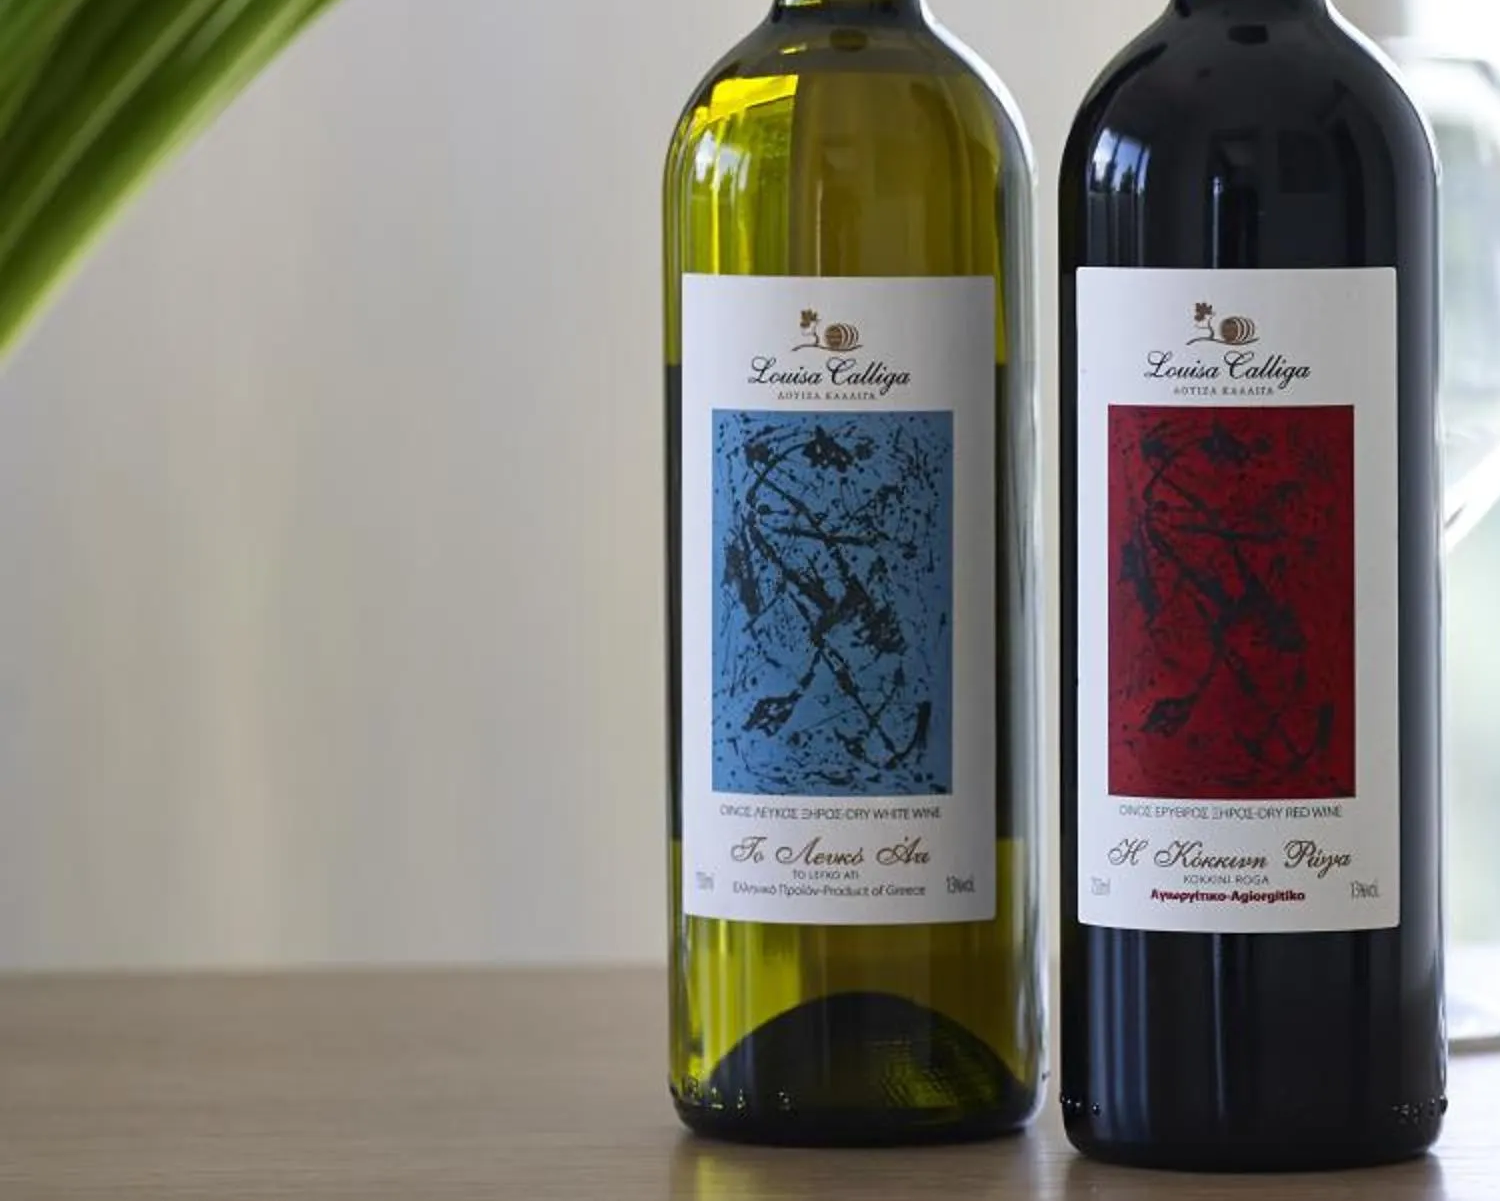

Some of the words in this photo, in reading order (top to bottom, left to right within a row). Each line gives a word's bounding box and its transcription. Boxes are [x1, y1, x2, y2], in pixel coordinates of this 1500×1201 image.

[748, 356, 822, 384] Louisa
[826, 356, 912, 396] Calliga
[1144, 350, 1220, 379] Louisa
[1223, 350, 1311, 390] Calliga
[872, 807, 910, 820] WHITE
[911, 805, 942, 819] WINE
[1285, 805, 1310, 818] RED
[1311, 804, 1343, 818] WINE
[730, 835, 768, 863] Το
[1108, 838, 1149, 867] Η
[871, 883, 885, 897] of
[885, 885, 926, 897] Greece
